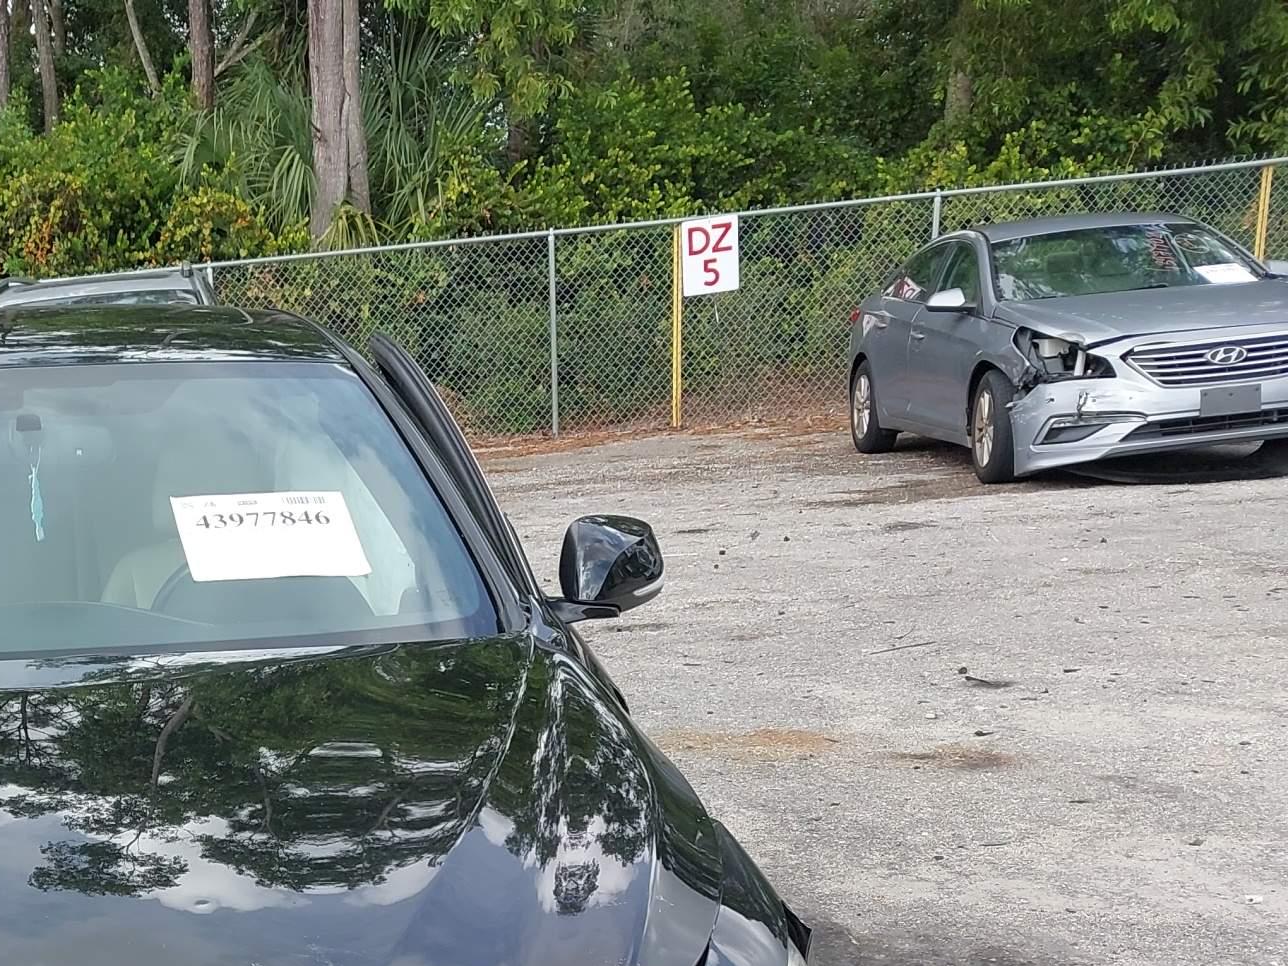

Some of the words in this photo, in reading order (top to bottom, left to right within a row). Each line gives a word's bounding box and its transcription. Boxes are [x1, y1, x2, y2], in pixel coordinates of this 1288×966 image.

[688, 222, 733, 256] DZ
[703, 258, 720, 287] 5
[195, 510, 330, 529] 43977846
